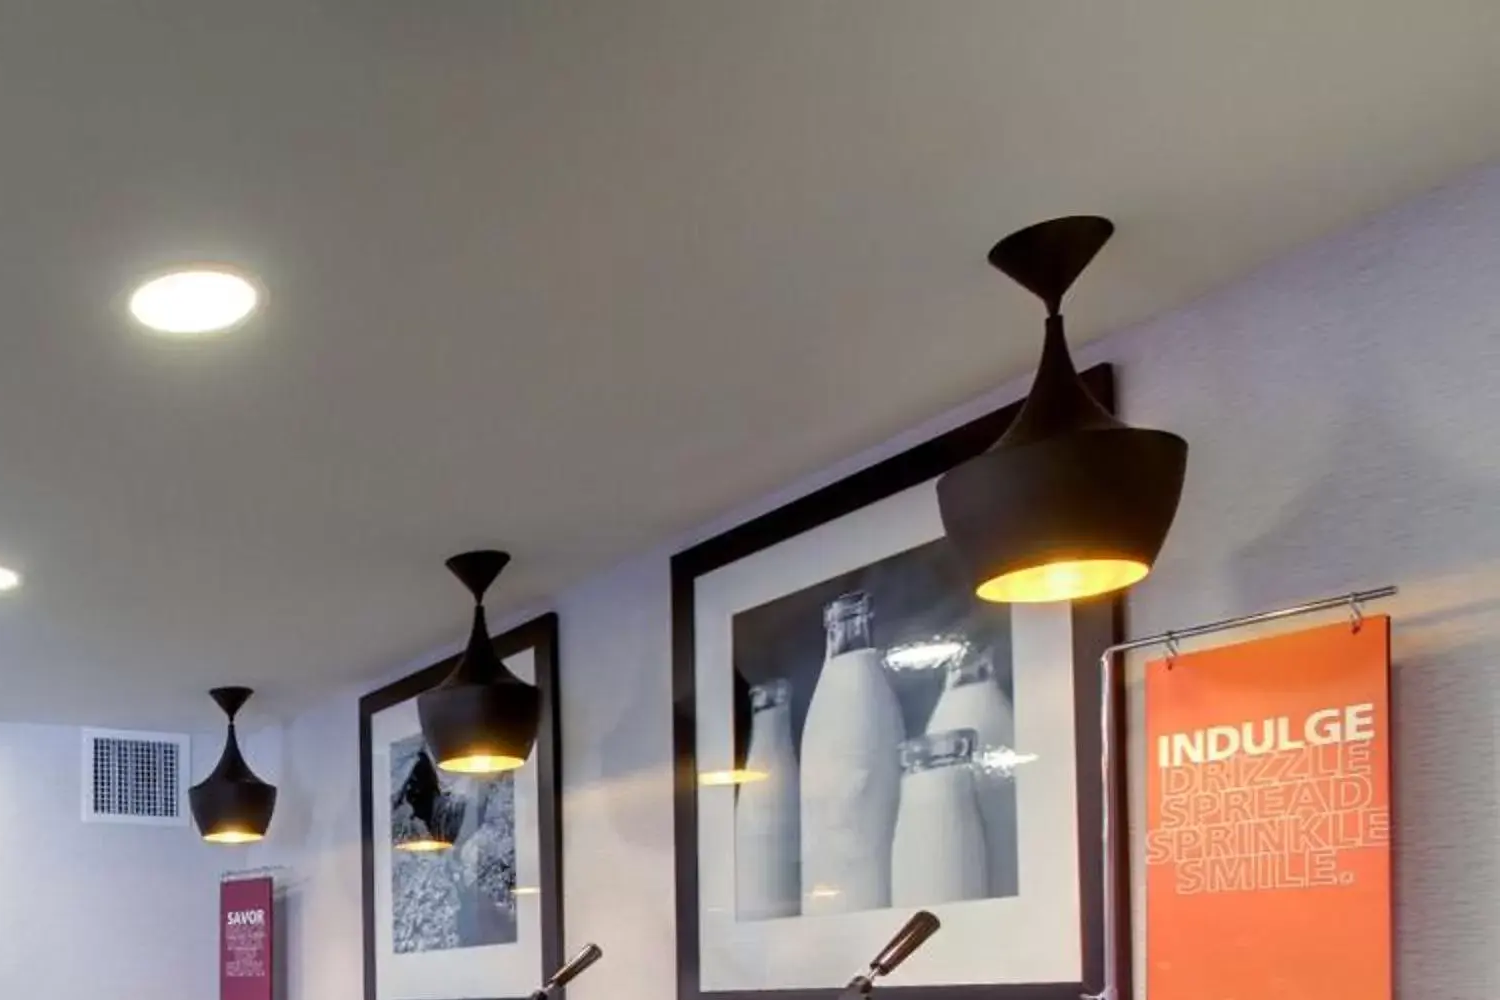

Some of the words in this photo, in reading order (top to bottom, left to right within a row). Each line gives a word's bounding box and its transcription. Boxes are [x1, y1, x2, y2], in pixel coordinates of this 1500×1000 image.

[1158, 703, 1375, 768] INDULGE
[1161, 741, 1372, 797] DRIZZLE
[1160, 774, 1374, 831] SPREAD
[1146, 808, 1391, 865] SPRINKLE
[1175, 848, 1356, 895] SMILE.
[227, 909, 265, 925] SAVOR
